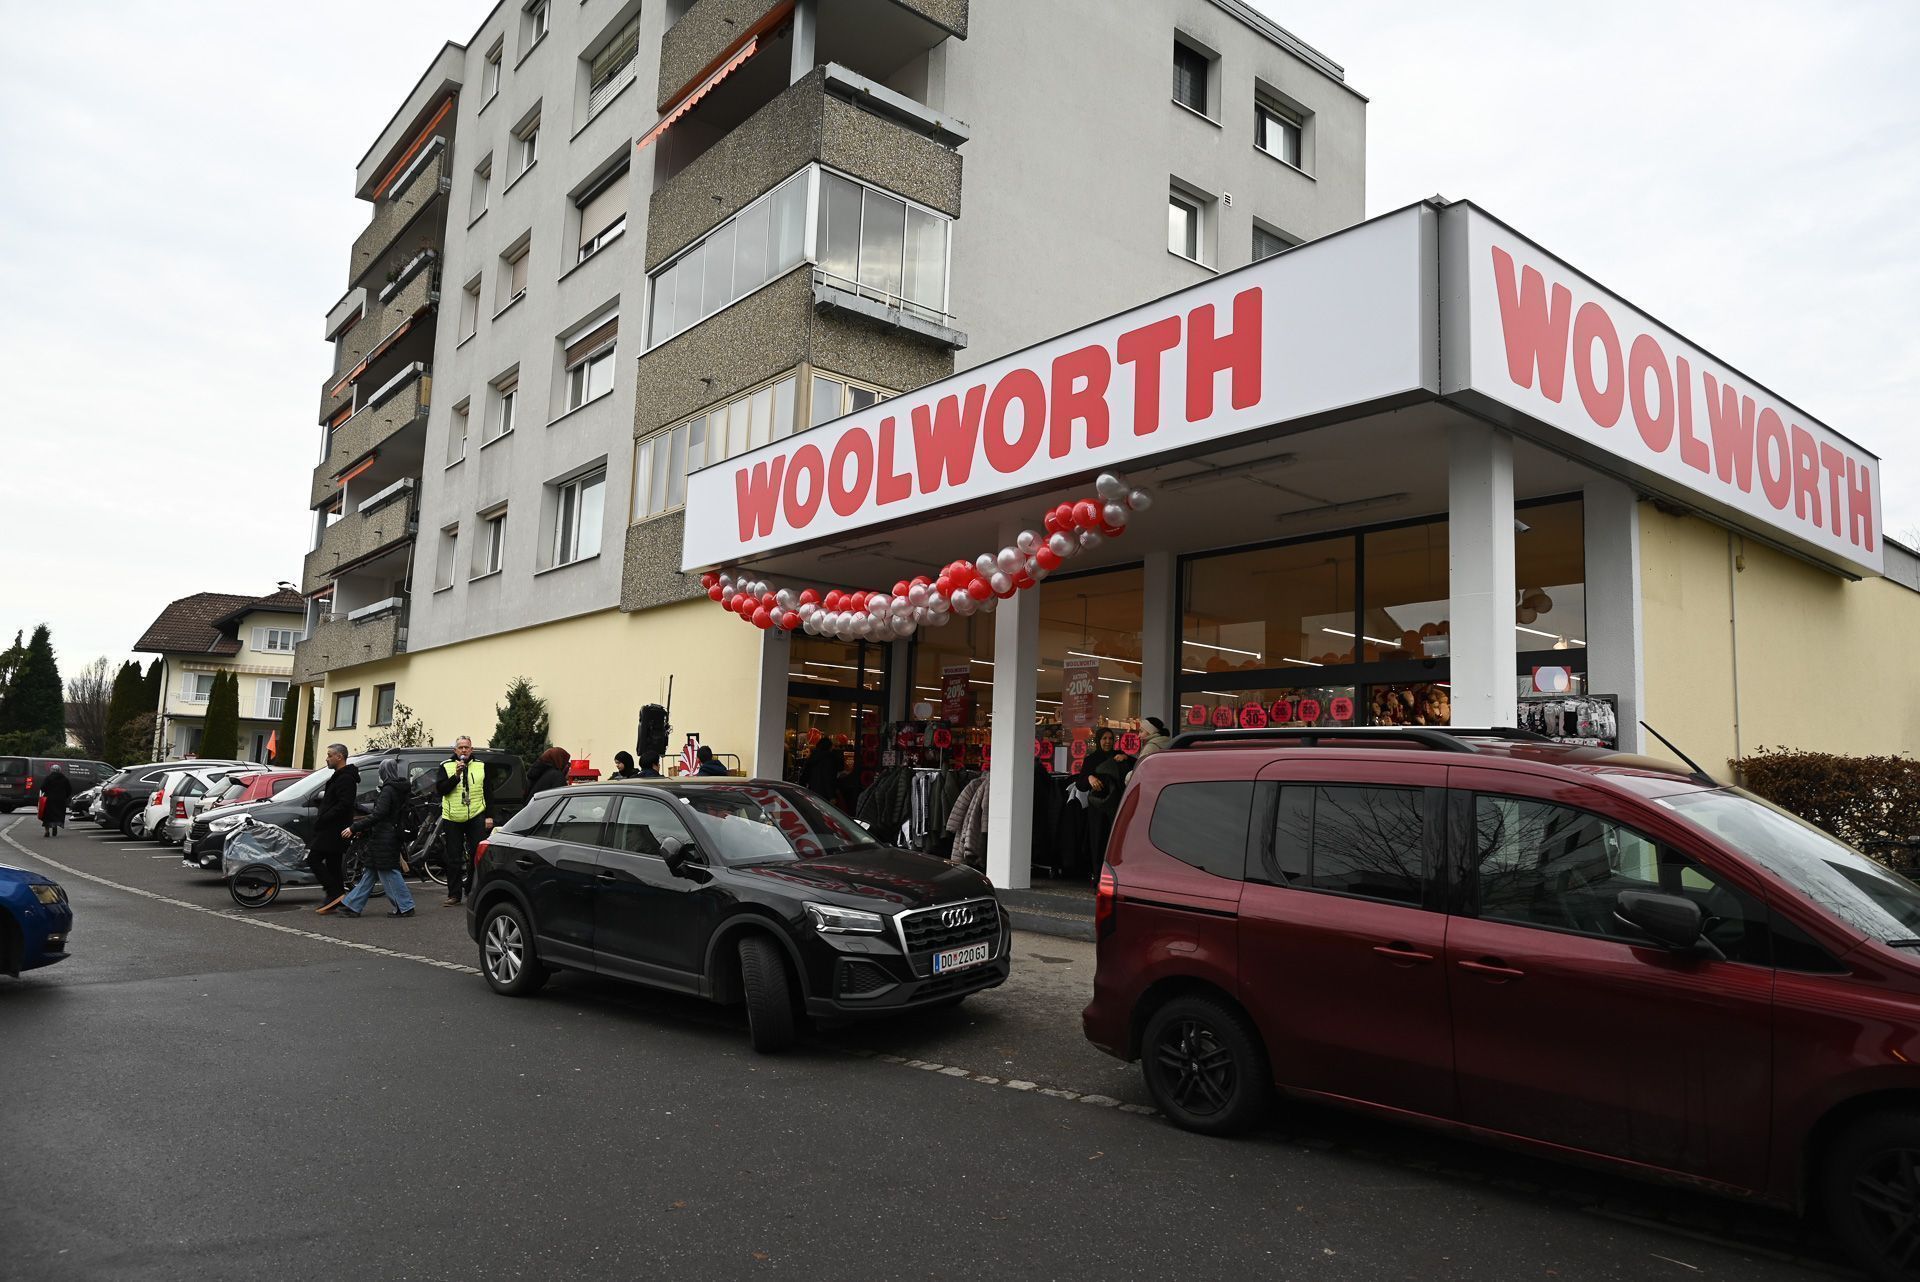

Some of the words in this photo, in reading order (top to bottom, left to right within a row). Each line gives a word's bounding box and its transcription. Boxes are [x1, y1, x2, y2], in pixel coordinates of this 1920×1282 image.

[736, 287, 1262, 543] WOOLWORTH
[1492, 245, 1874, 553] WOOLWORTH
[941, 954, 953, 968] DO
[958, 948, 974, 964] 220
[975, 946, 986, 960] GJ
